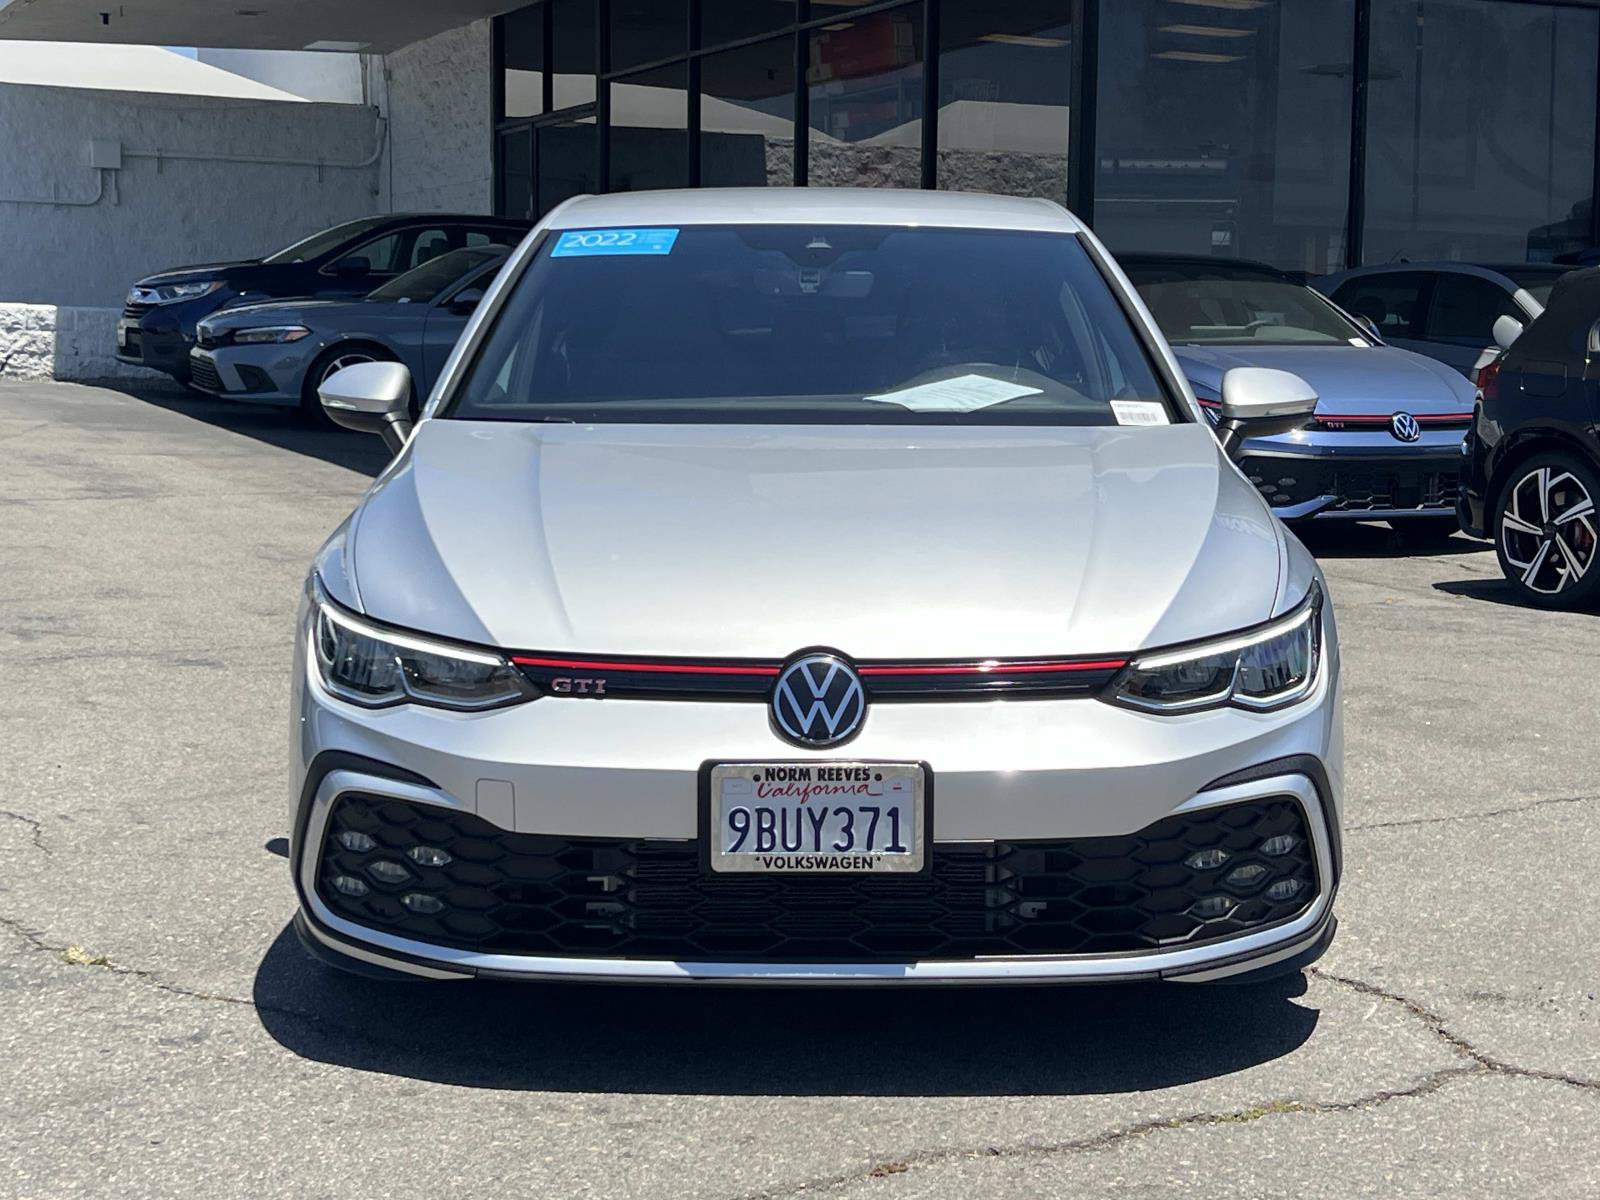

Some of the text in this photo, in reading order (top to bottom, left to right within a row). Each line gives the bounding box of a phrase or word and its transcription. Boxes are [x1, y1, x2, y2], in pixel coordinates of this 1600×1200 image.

[564, 232, 637, 248] 2022
[551, 677, 607, 694] GTI
[776, 656, 863, 739] VW
[765, 768, 871, 781] NORM REEVES
[757, 782, 882, 804] California
[728, 806, 906, 853] 9BUY371
[763, 856, 874, 869] VOLKSWAGEN
